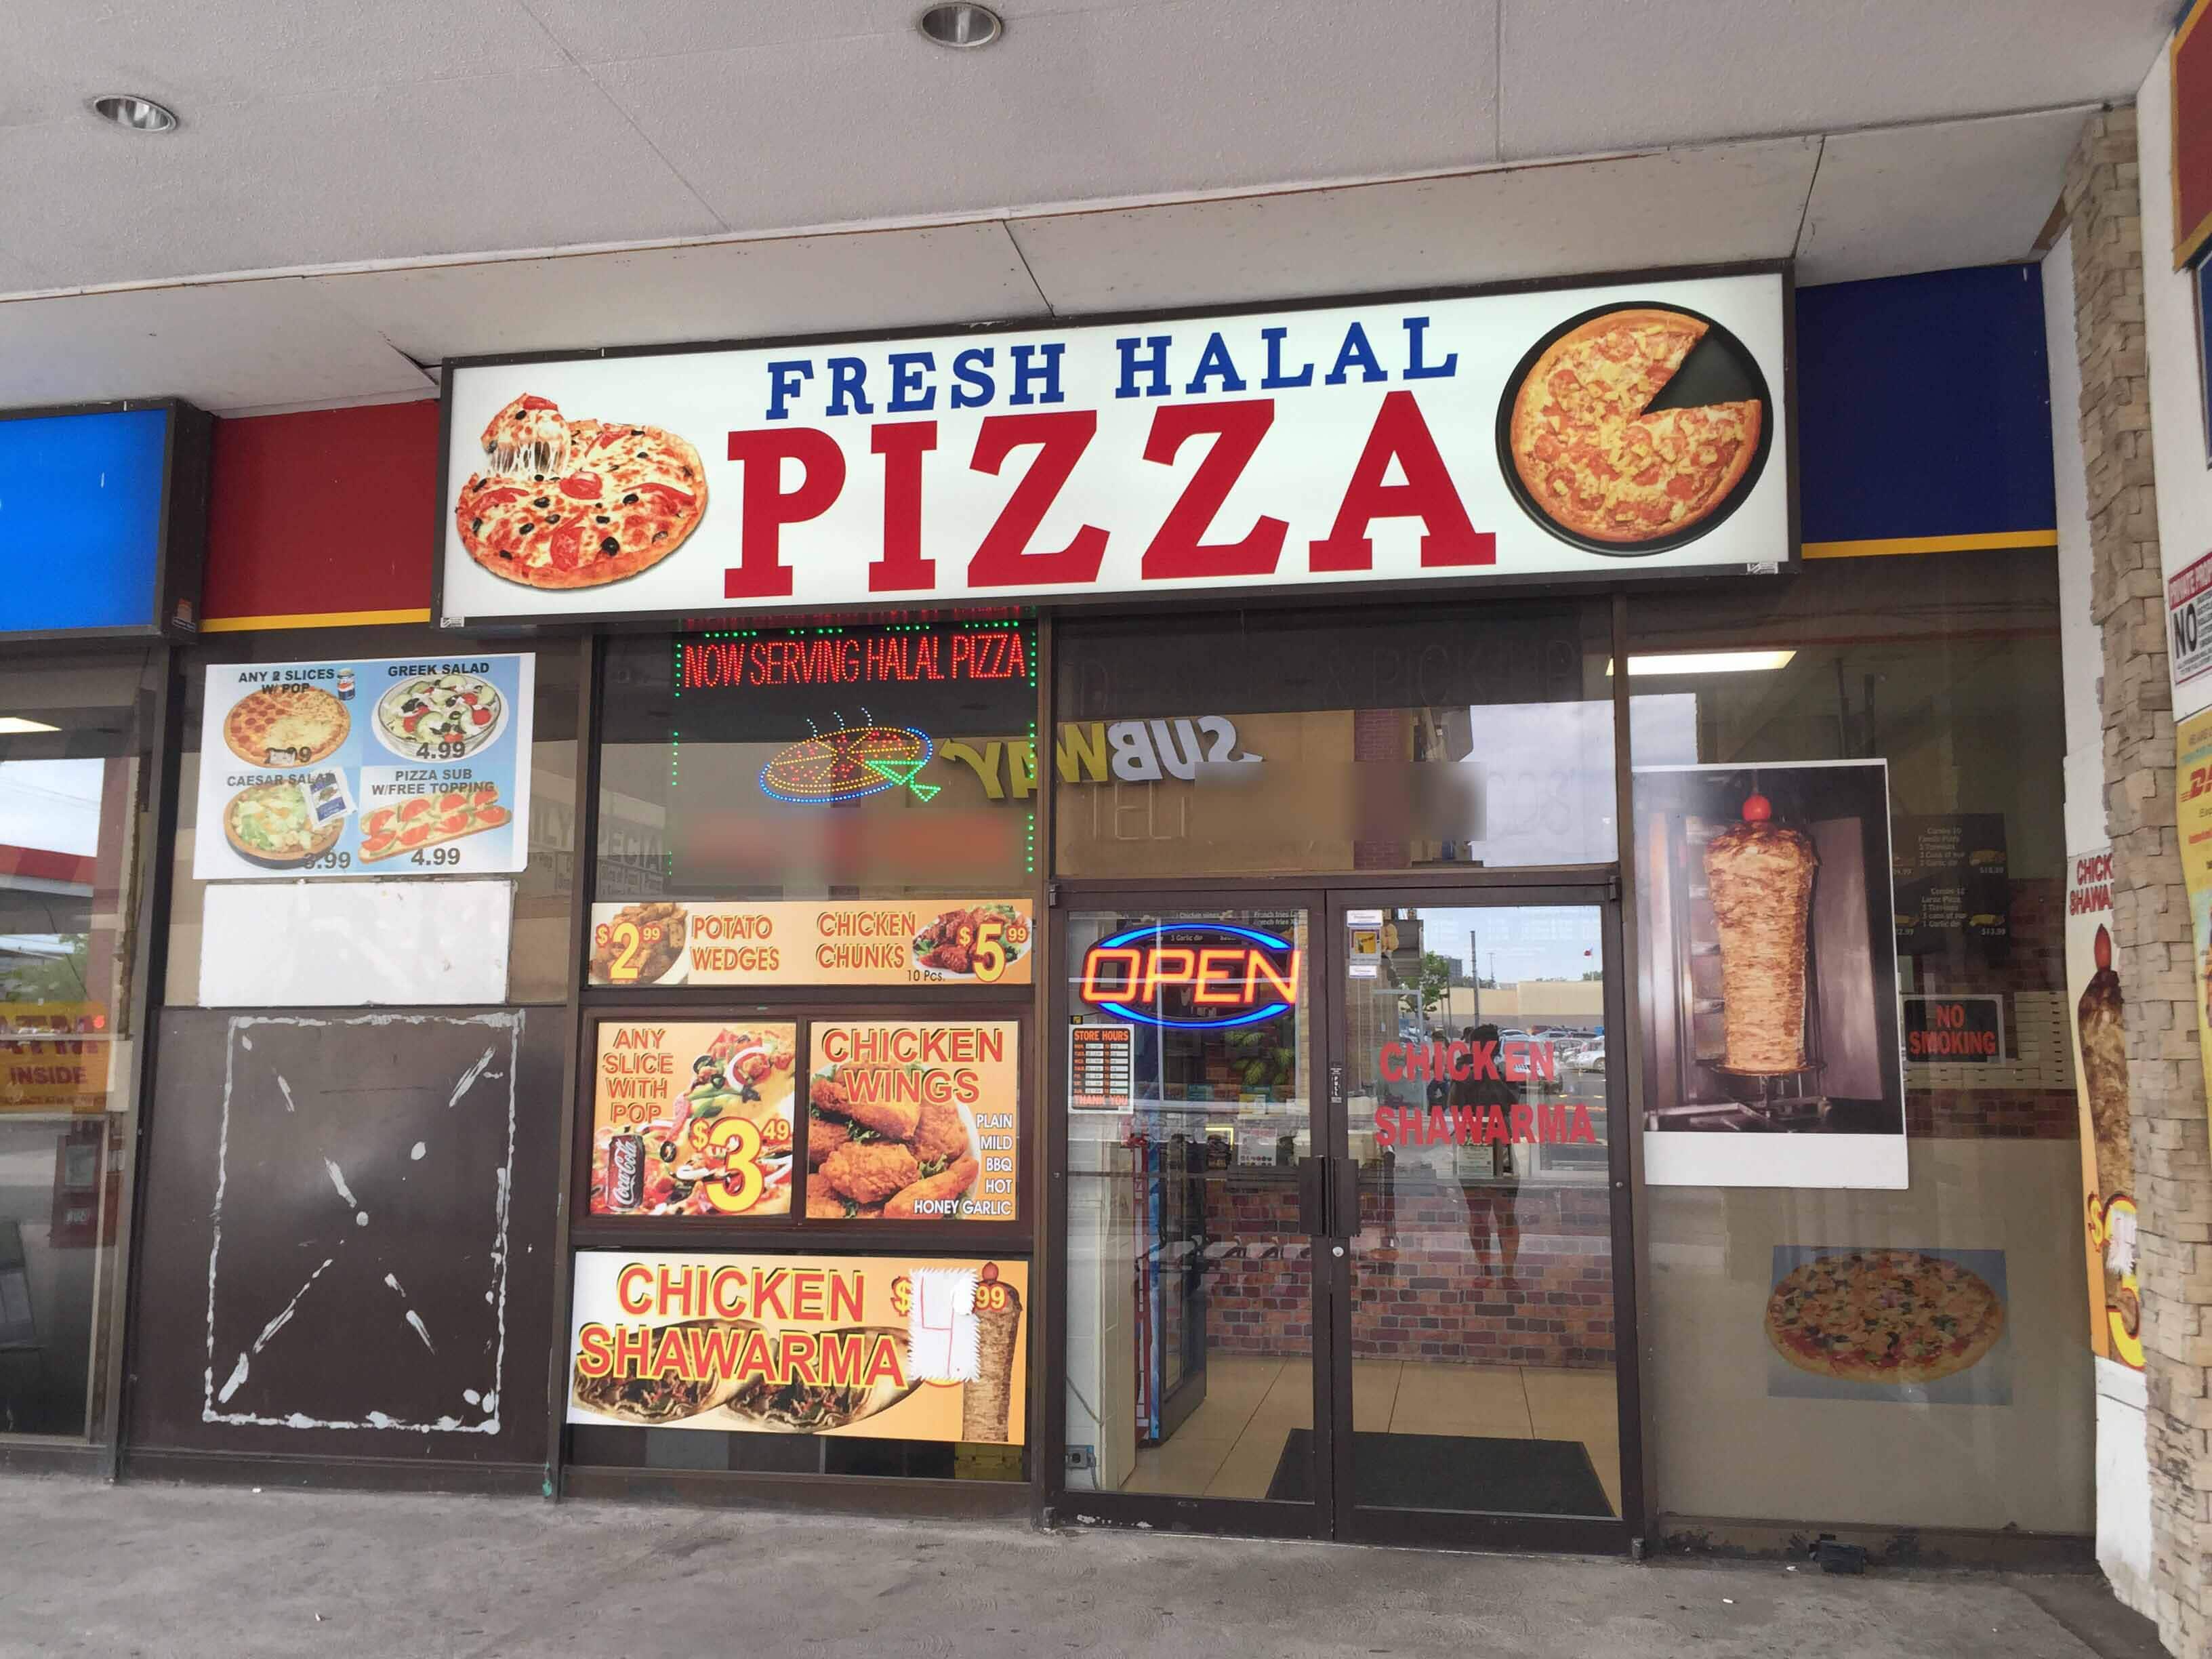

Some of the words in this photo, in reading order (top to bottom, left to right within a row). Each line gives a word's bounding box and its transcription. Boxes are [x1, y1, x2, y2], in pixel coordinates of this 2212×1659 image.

[766, 343, 1065, 420] FRESH
[1115, 316, 1458, 398] HALAL
[724, 390, 1496, 598] PIZZA
[2173, 603, 2197, 659] NO
[388, 665, 437, 676] GREEK
[442, 663, 490, 675] SALAD
[684, 642, 746, 687] NOW
[750, 639, 860, 684] SERVING
[867, 635, 945, 682] HALAL
[950, 632, 1026, 678] PIZZA
[239, 671, 268, 683] ANY
[285, 668, 335, 681] SLICES
[282, 683, 310, 694] POP
[416, 742, 466, 759] 4.99
[227, 775, 283, 787] CAESAR
[395, 770, 437, 781] PIZZA
[443, 769, 472, 779] SUB
[371, 783, 426, 796] W/FREE
[430, 781, 495, 794] TOPPING
[411, 848, 461, 866] 4.99
[690, 913, 773, 939] POTATO
[815, 910, 917, 937] CHICKEN
[690, 945, 780, 972] WEDGES
[815, 943, 906, 969] CHUNKS
[907, 970, 922, 982] 10
[1082, 947, 1302, 1004] OPEN
[1936, 1003, 1965, 1028] NO
[613, 1029, 666, 1049] ANY
[822, 1028, 1004, 1063] CHICKEN
[1073, 1030, 1100, 1041] STORE
[1103, 1030, 1128, 1041] HOURS
[1909, 1030, 1996, 1057] SMOKING
[603, 1052, 674, 1074] SLICE
[1380, 1041, 1555, 1082] CHICKEN
[10, 1066, 87, 1085] INSIDE
[606, 1078, 668, 1099] WITH
[842, 1069, 980, 1104] WINGS
[611, 1103, 662, 1123] POP
[976, 1113, 1013, 1128] PLAIN
[1374, 1103, 1596, 1147] SHAWARMA
[980, 1136, 1012, 1151] MILD
[985, 1158, 1012, 1173] BBQ
[985, 1179, 1012, 1194] HOT
[914, 1200, 960, 1215] HONEY
[962, 1200, 1012, 1216] GARLIC
[617, 1263, 864, 1322] CHICKEN
[577, 1322, 908, 1389] SHAWARMA
